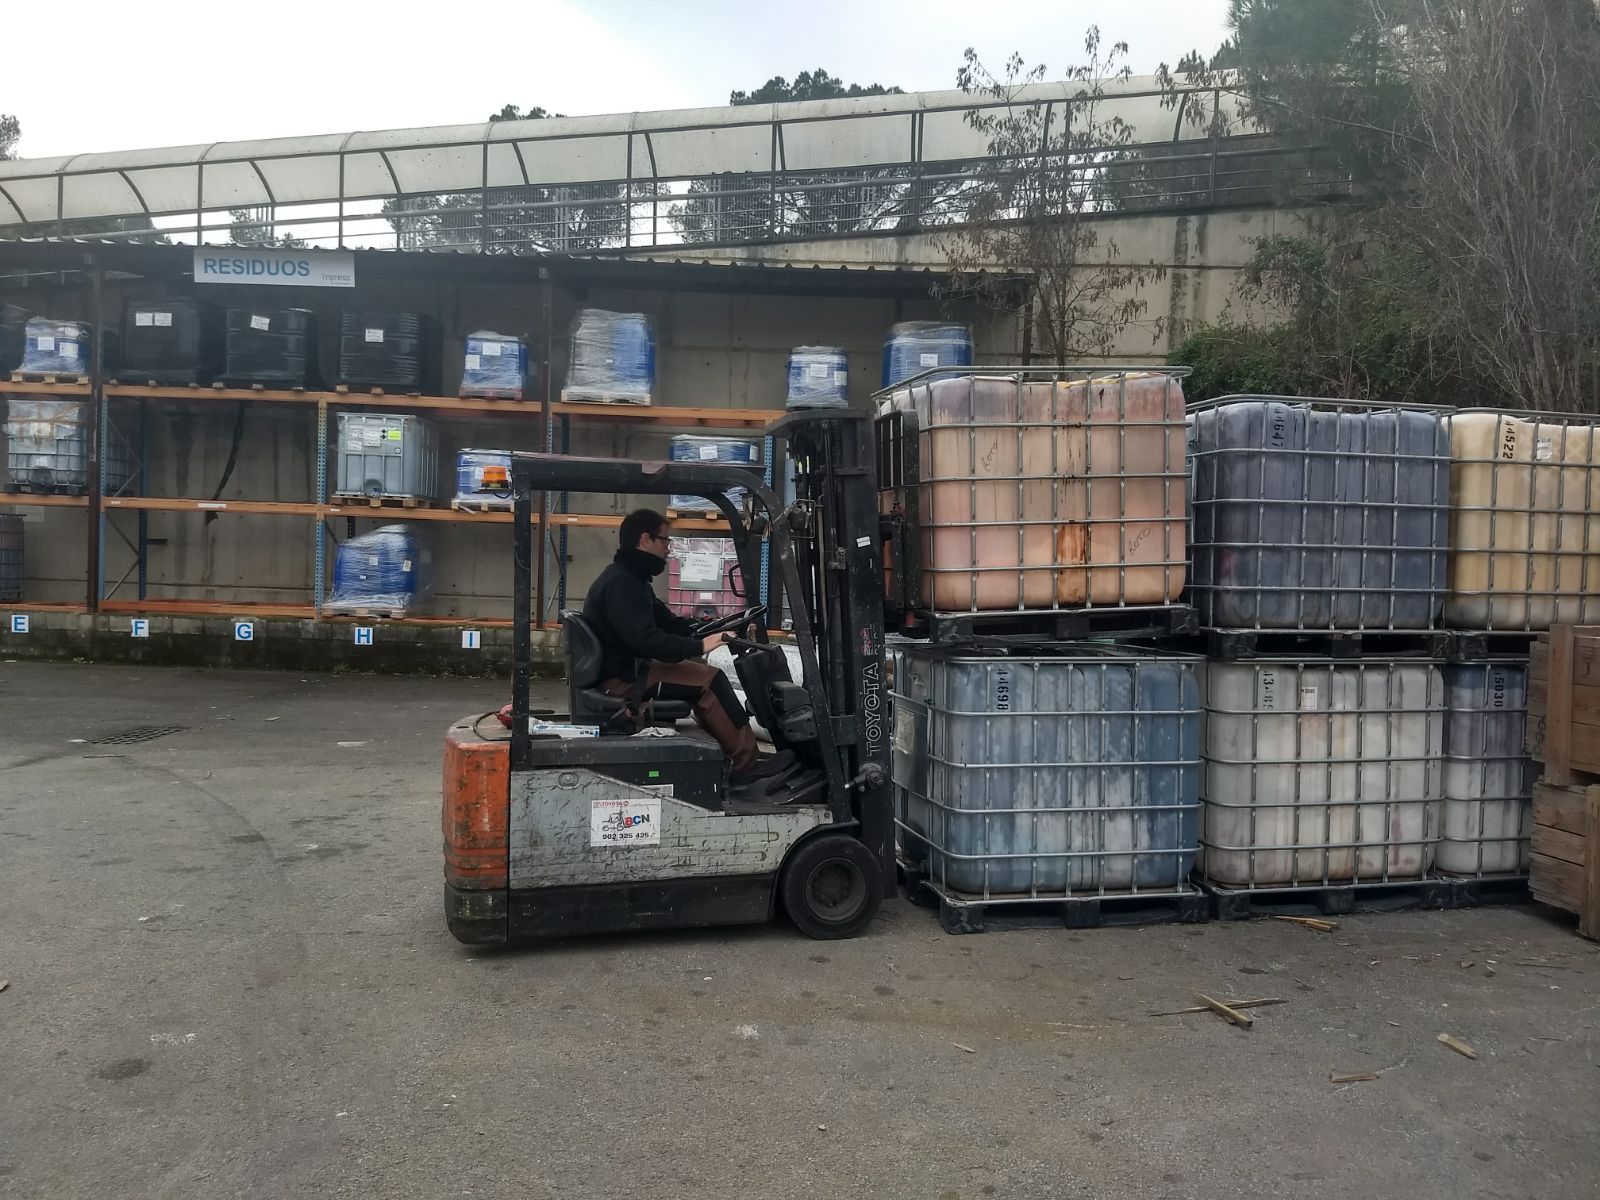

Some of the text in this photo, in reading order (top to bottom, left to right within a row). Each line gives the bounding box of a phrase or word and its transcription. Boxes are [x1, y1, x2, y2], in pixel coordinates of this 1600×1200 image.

[203, 258, 310, 277] RESIDUOS
[14, 616, 26, 632] E
[134, 621, 145, 636] F
[237, 624, 252, 640] G
[357, 628, 371, 644] H
[863, 662, 882, 757] TOYOTA
[624, 814, 650, 827] BCN
